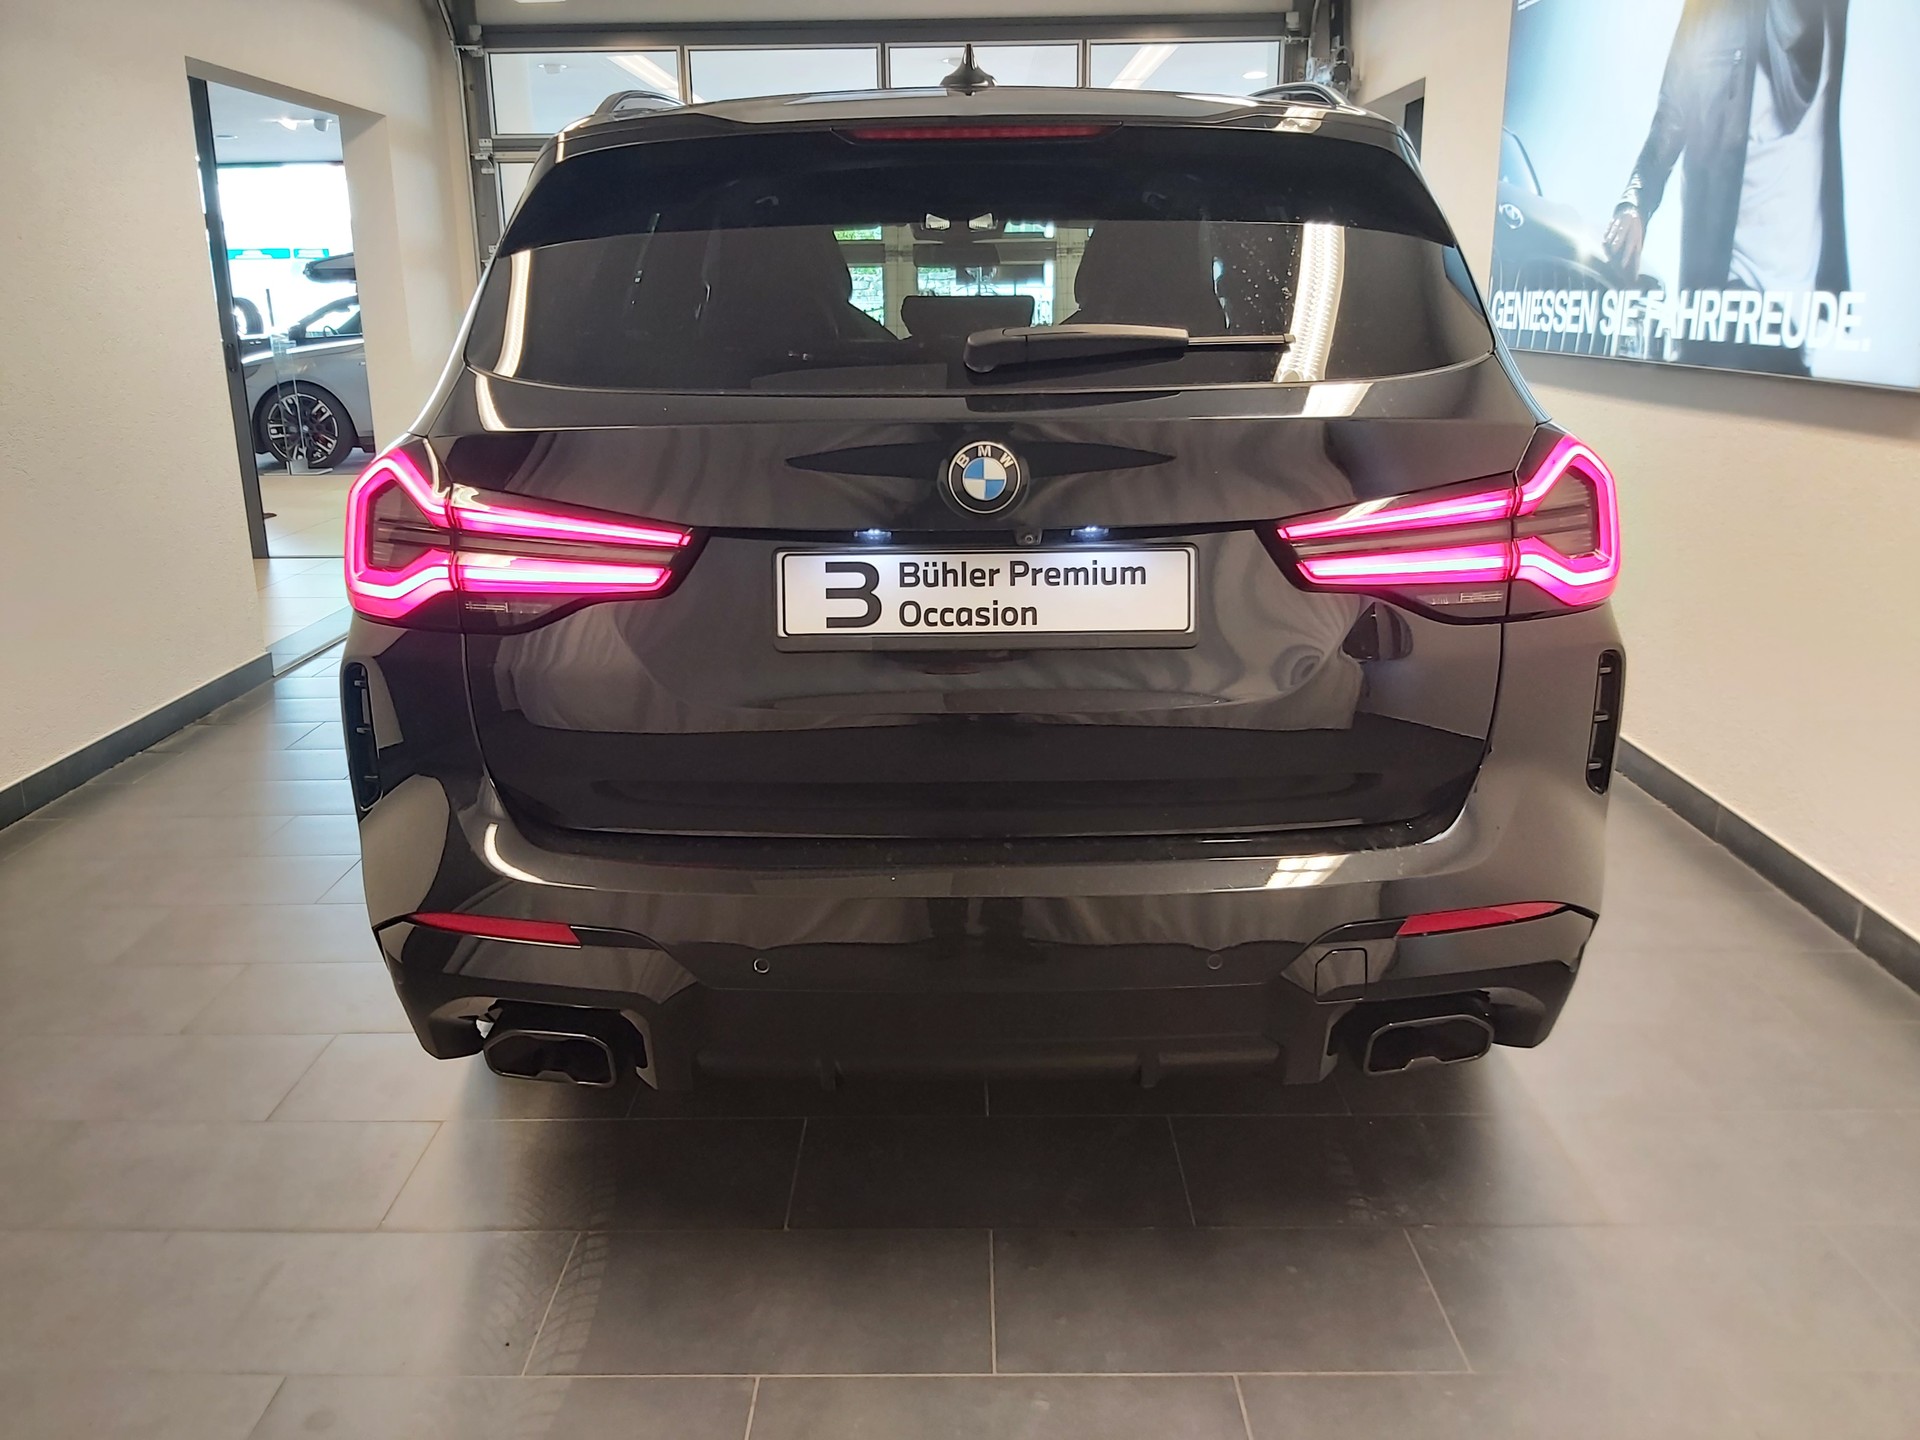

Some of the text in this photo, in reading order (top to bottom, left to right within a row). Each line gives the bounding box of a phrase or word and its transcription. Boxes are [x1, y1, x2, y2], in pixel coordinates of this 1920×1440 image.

[1491, 289, 1597, 334] GENIESSEN
[1599, 289, 1641, 336] SIE
[956, 445, 1014, 469] BMW
[899, 559, 1147, 588] Bühler Premium
[899, 600, 1038, 627] Occasion
